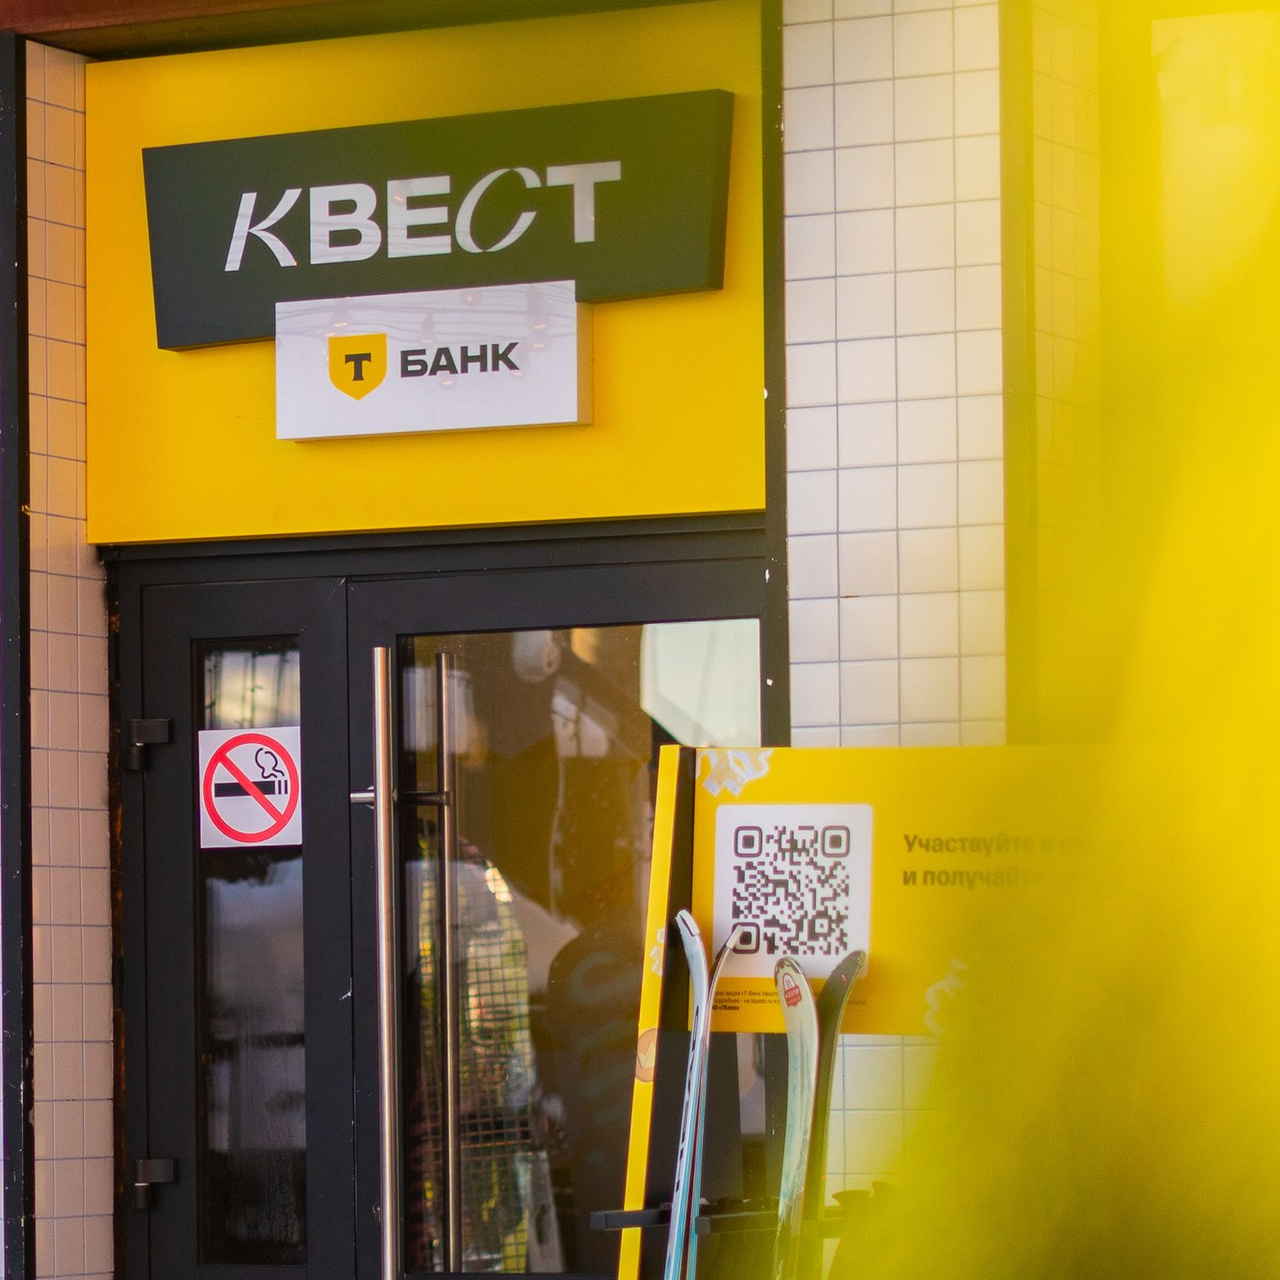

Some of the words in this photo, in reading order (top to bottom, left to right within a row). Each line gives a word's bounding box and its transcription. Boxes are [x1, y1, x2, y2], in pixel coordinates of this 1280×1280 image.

[223, 159, 622, 272] КВЕСТ
[399, 342, 521, 379] БАНК
[903, 833, 1036, 856] Участвуйте
[902, 870, 918, 887] и
[922, 866, 1042, 891] получай
